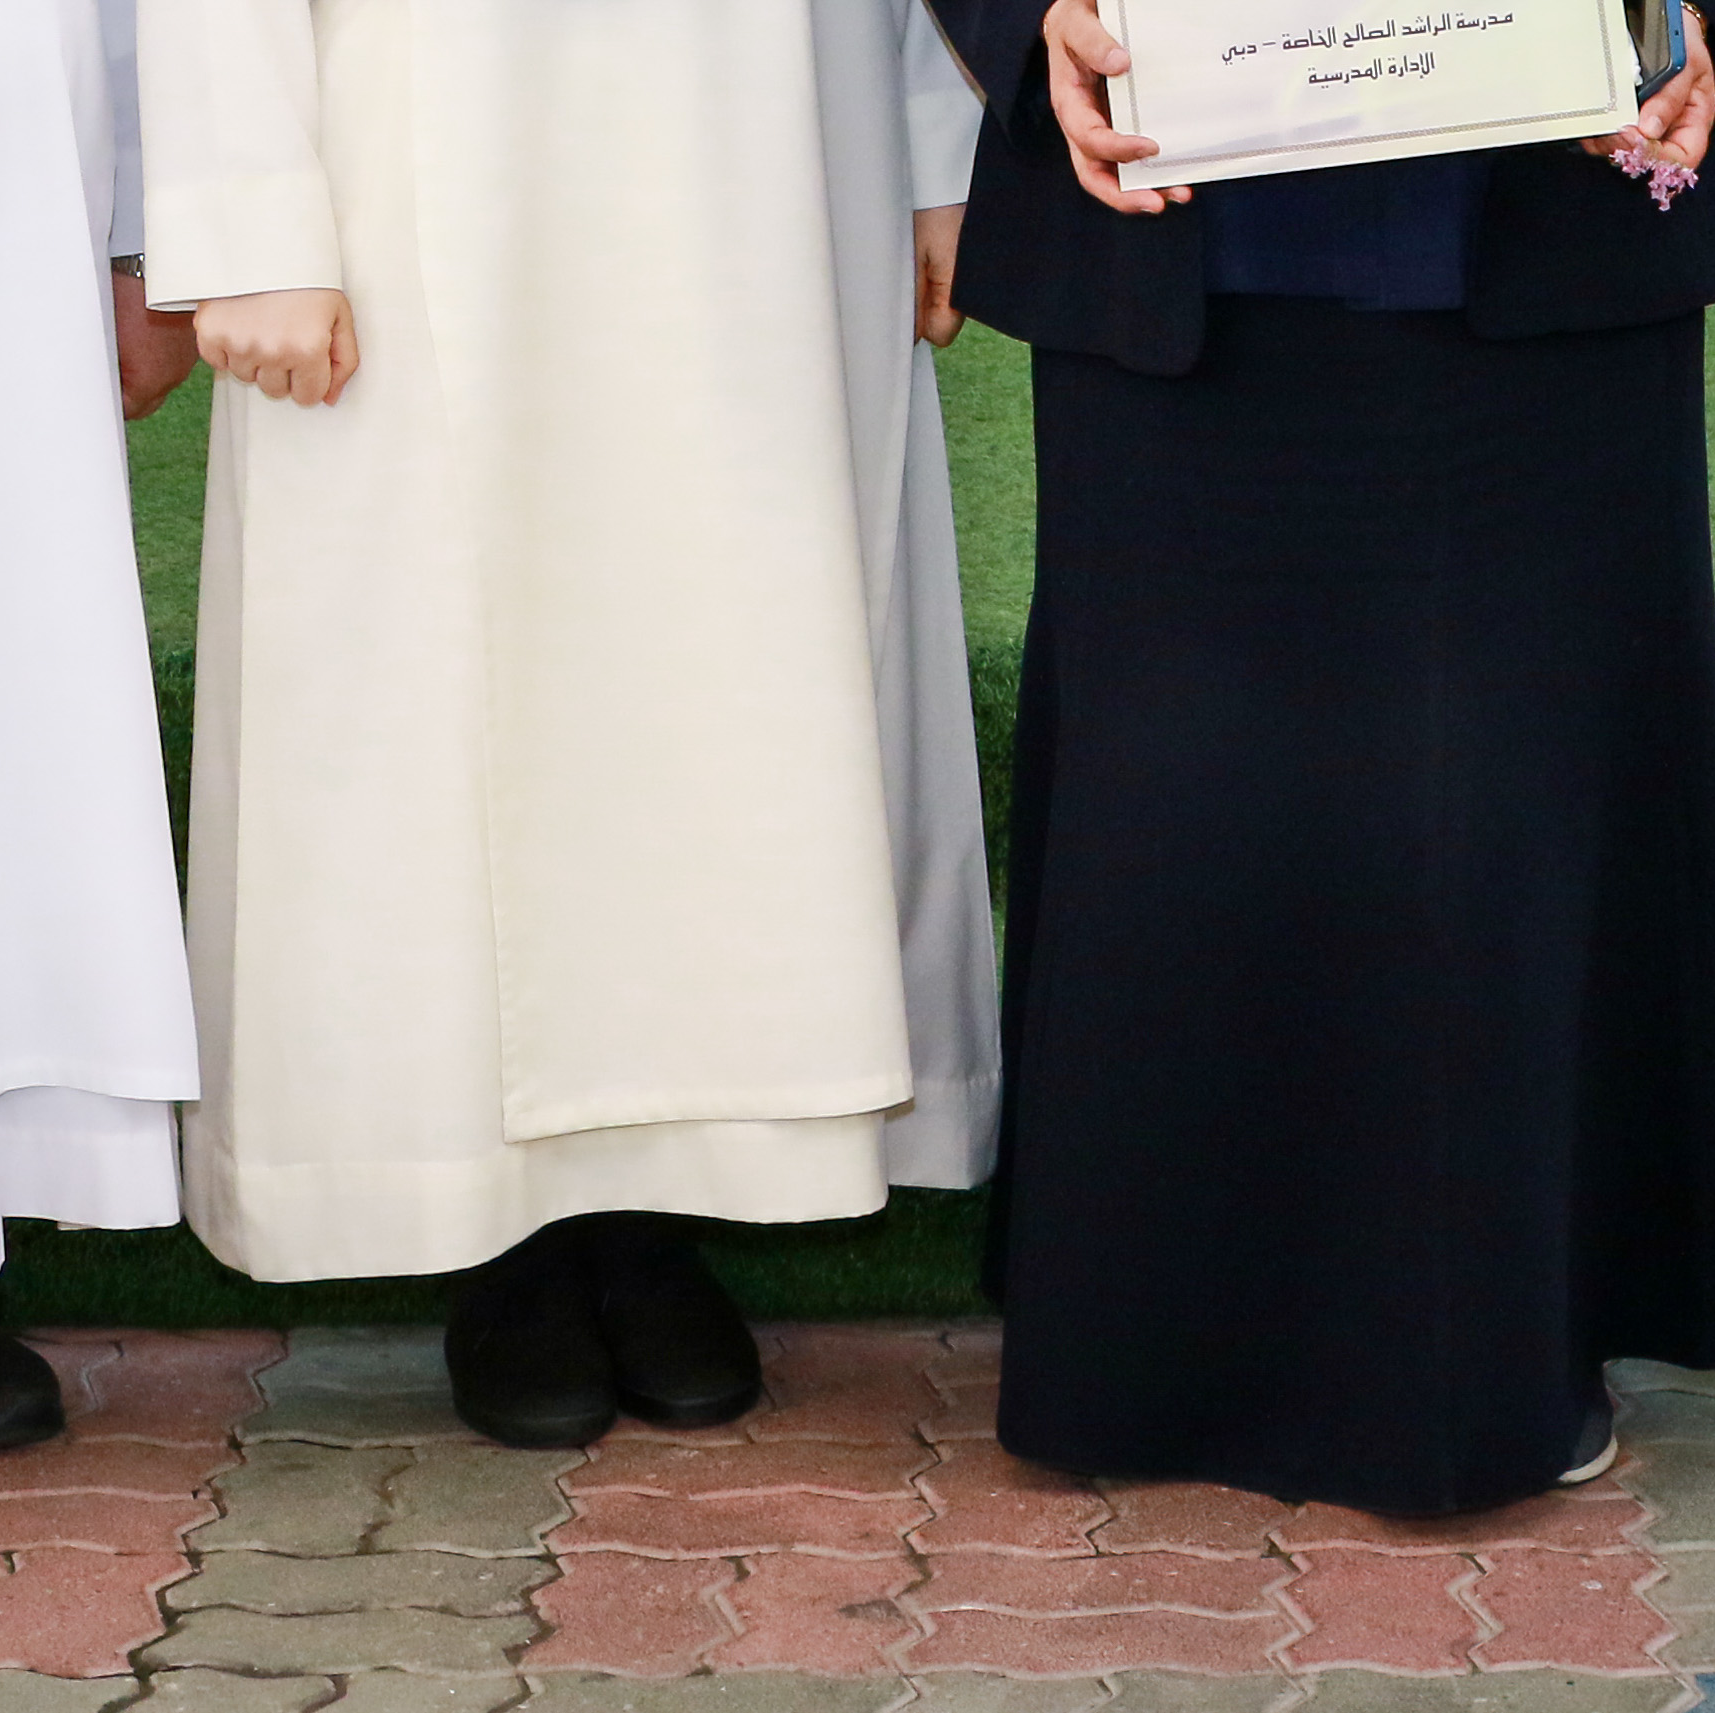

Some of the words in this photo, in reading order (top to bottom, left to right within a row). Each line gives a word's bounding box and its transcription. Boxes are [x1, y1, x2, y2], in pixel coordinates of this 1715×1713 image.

[1402, 13, 1451, 37] الراشد
[1456, 11, 1514, 30] مدرسة
[1282, 26, 1337, 51] الخاصة
[1342, 19, 1396, 48] الصالح
[1221, 43, 1257, 66] دبي
[1388, 52, 1436, 79] الإدارة
[1308, 58, 1383, 89] المدرسية
